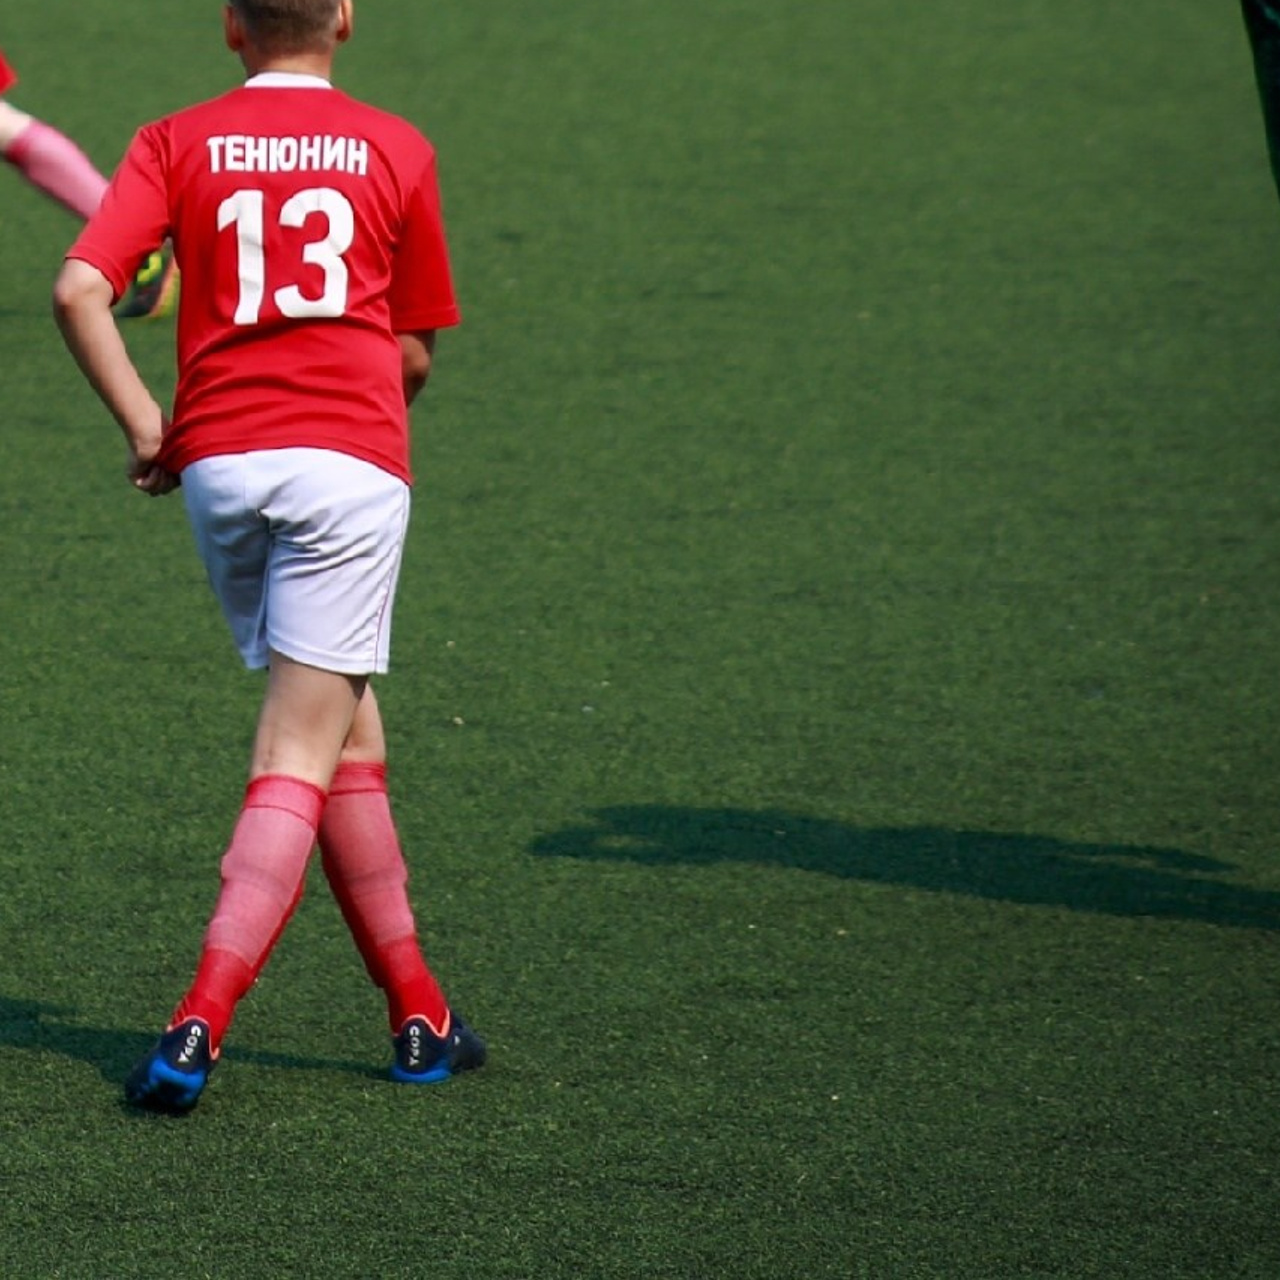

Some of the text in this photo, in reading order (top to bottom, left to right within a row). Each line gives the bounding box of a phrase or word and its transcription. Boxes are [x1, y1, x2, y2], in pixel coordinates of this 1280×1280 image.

[207, 134, 368, 176] ТЕНЮНИН
[217, 187, 355, 325] 13
[177, 1024, 202, 1063] COPA
[409, 1025, 420, 1066] COPA
